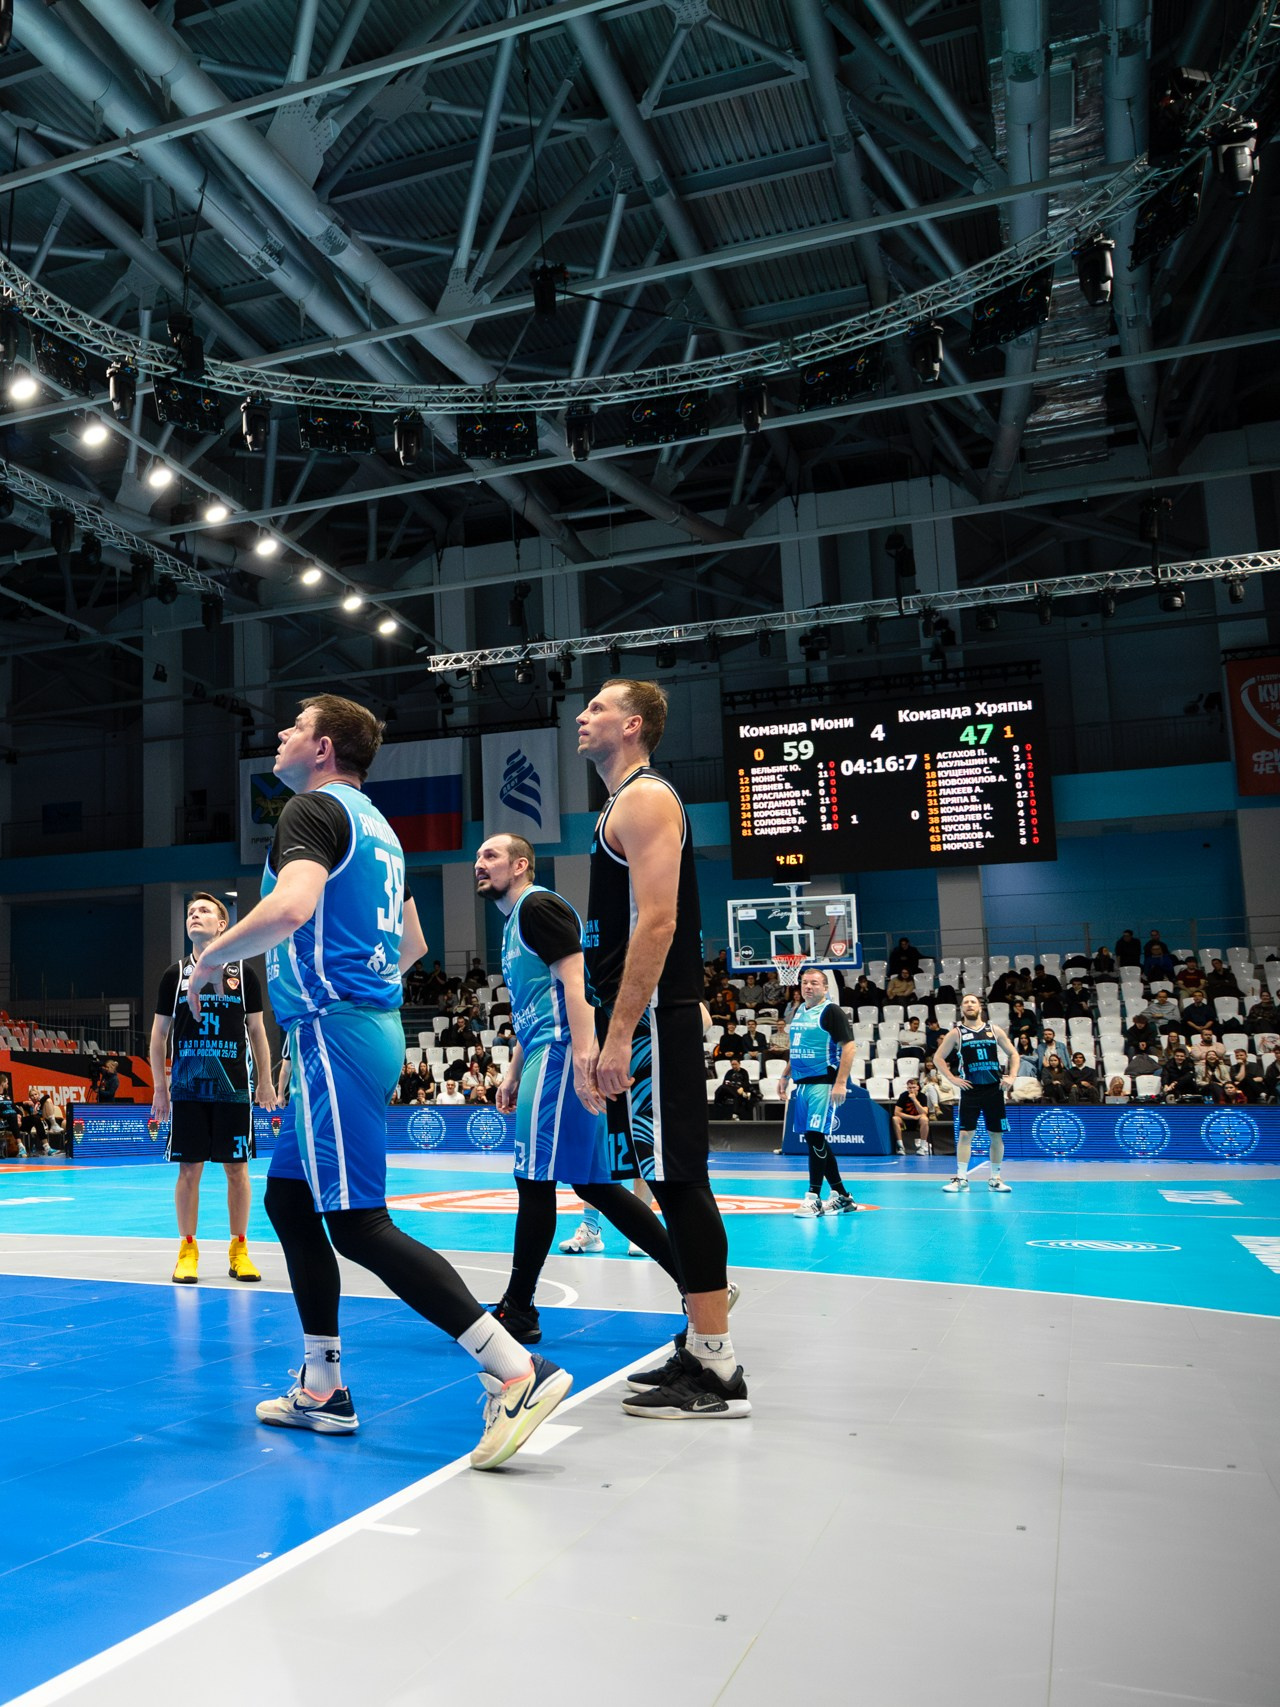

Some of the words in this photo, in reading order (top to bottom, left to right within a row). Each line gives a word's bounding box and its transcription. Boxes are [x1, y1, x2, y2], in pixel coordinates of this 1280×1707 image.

[1258, 683, 1280, 703] КУ
[898, 706, 971, 723] Команда
[975, 700, 1033, 716] Хряпы
[739, 722, 807, 738] Команда
[811, 717, 854, 731] Мони
[870, 724, 886, 742] 4
[959, 723, 994, 746] 47
[1003, 725, 1014, 738] 1
[754, 748, 764, 761] 0
[783, 740, 814, 762] 59
[936, 750, 976, 760] АСТАХОВ
[840, 754, 917, 776] 04:16:7
[937, 758, 987, 768] АКУЛЬШИН
[1014, 754, 1020, 762] 2
[751, 766, 788, 774] ВЕЛЬБИК
[937, 767, 982, 778] КУЩЕНКО
[1015, 763, 1026, 771] 14
[1253, 762, 1280, 775] ЧЕ
[751, 775, 775, 783] МОНЯ
[938, 776, 996, 787] НОВОЖИЛОВ
[752, 783, 783, 792] ПЕВНЕВ
[939, 786, 973, 796] ЛАКЕЕВ
[752, 791, 800, 801] АРАСЛАНОВ
[939, 796, 969, 805] ХРЯПА
[753, 800, 796, 809] БОГДАНОВ
[940, 804, 982, 814] КОЧАРЯН
[753, 809, 792, 818] КОРОБЕЦ
[911, 810, 919, 820] 0
[941, 813, 982, 823] ЯКОВЛЕВ
[754, 817, 796, 826] СОЛОВЬЕВ
[798, 816, 807, 824] Д.
[851, 815, 859, 824] 1
[754, 826, 792, 835] САНДЛЕР
[821, 823, 832, 831] 18
[941, 823, 971, 832] ЧУСОВ
[942, 831, 984, 841] ГОЛЯХОВ
[943, 842, 974, 850] МОРОЗ
[374, 847, 404, 937] 38
[198, 1012, 219, 1035] 34
[178, 1040, 237, 1050] ГАЗПРОМБАНК
[197, 1049, 220, 1057] РОССИИ
[221, 1050, 237, 1059] 25/26
[976, 1048, 988, 1060] 81
[799, 1135, 864, 1143] ГОМБАНК
[608, 1132, 634, 1171] 12
